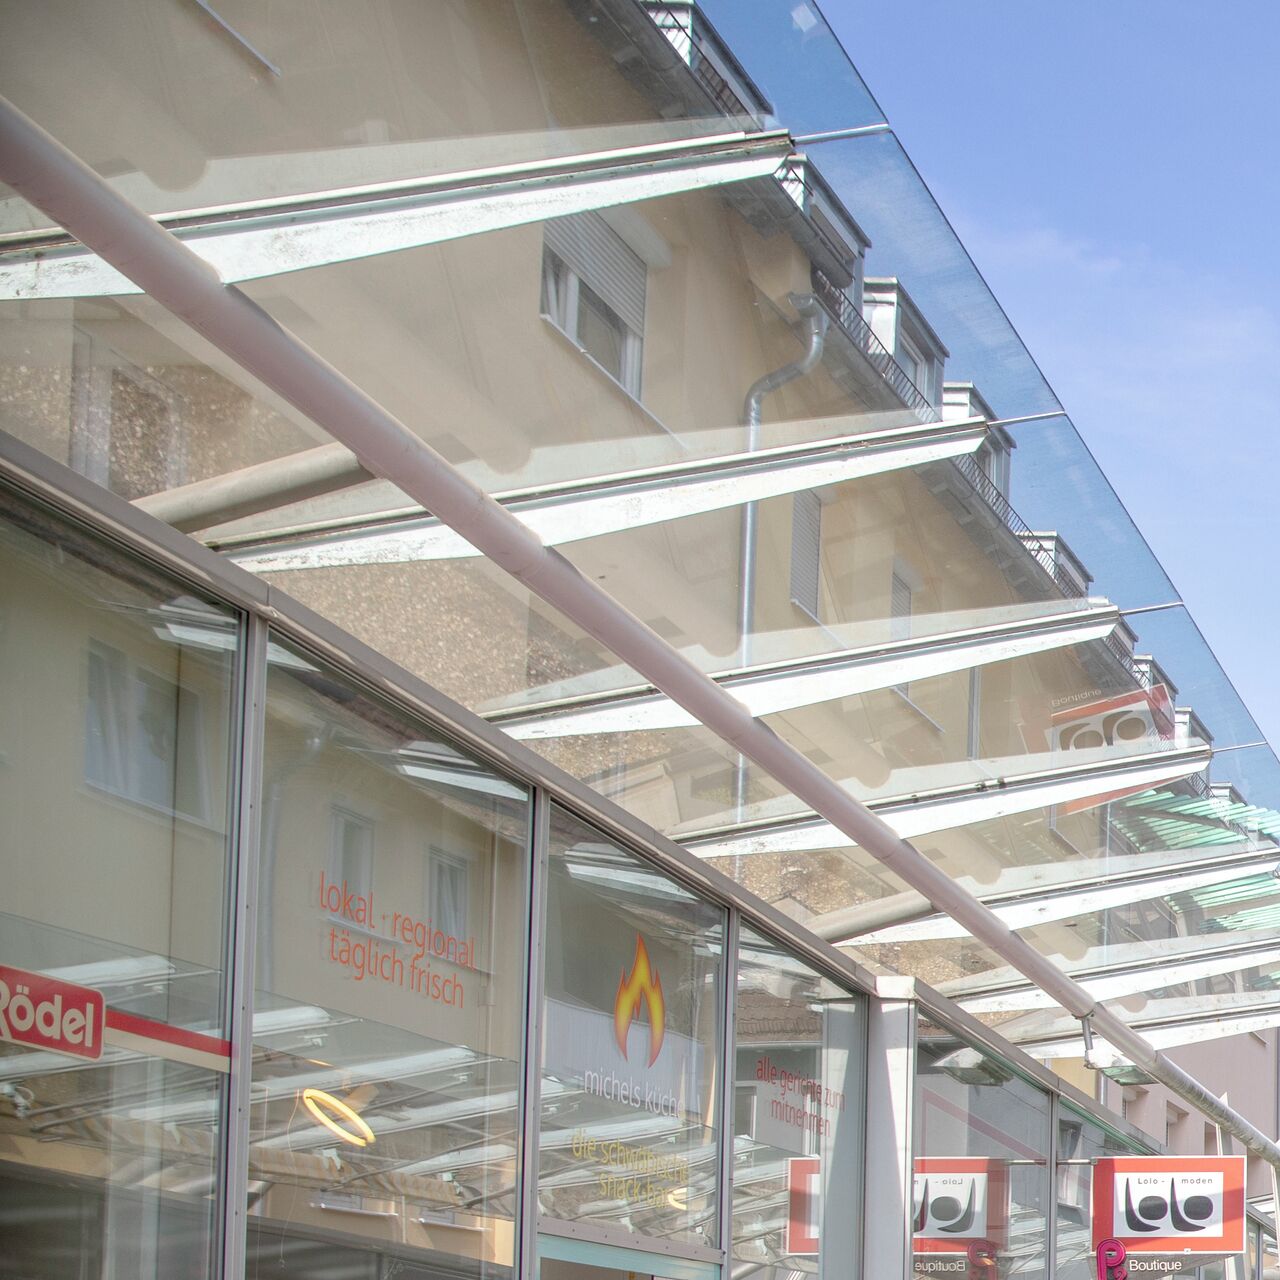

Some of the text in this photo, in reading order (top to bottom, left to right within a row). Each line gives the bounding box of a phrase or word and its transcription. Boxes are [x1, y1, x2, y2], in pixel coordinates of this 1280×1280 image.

[319, 870, 478, 972] lokal regional
[329, 927, 465, 1009] täglich frisch
[584, 1067, 641, 1109] michels
[756, 1055, 777, 1085] alle
[1129, 1259, 1182, 1273] Boutique
